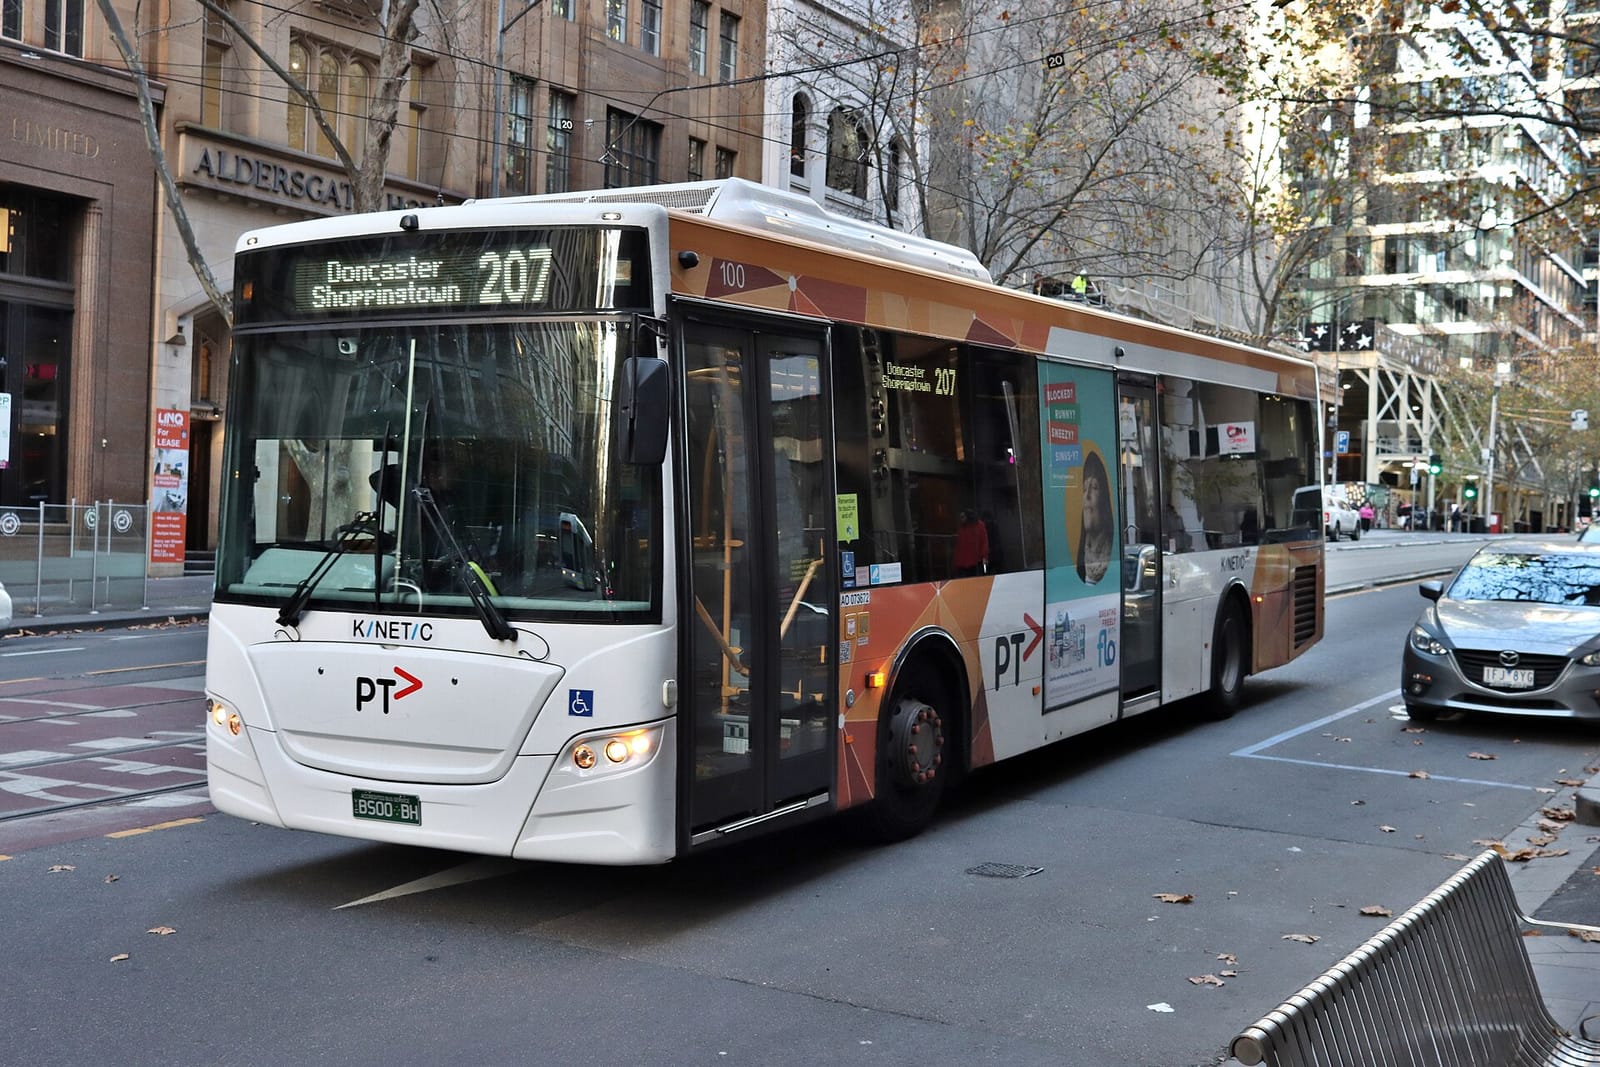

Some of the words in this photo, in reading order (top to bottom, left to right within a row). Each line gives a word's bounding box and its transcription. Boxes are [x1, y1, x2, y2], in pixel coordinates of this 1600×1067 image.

[1048, 55, 1062, 67] 20
[561, 119, 573, 130] 20
[11, 118, 99, 158] LIMITED
[193, 148, 355, 209] ALDERSGAT
[327, 256, 443, 283] Doncaster
[479, 249, 553, 304] 207
[720, 261, 745, 289] 100
[312, 282, 461, 308] Shoppingtown
[934, 367, 956, 396] 207
[1047, 388, 1074, 401] BLOCKED?
[158, 412, 184, 426] LINQ
[1054, 409, 1076, 420] RUNNY?
[157, 428, 169, 437] For
[157, 438, 181, 448] LEASE
[1051, 427, 1075, 441] SNEEZY?
[1096, 628, 1116, 669] flo
[995, 632, 1026, 692] PT
[356, 676, 397, 715] PT
[401, 803, 418, 820] BH
